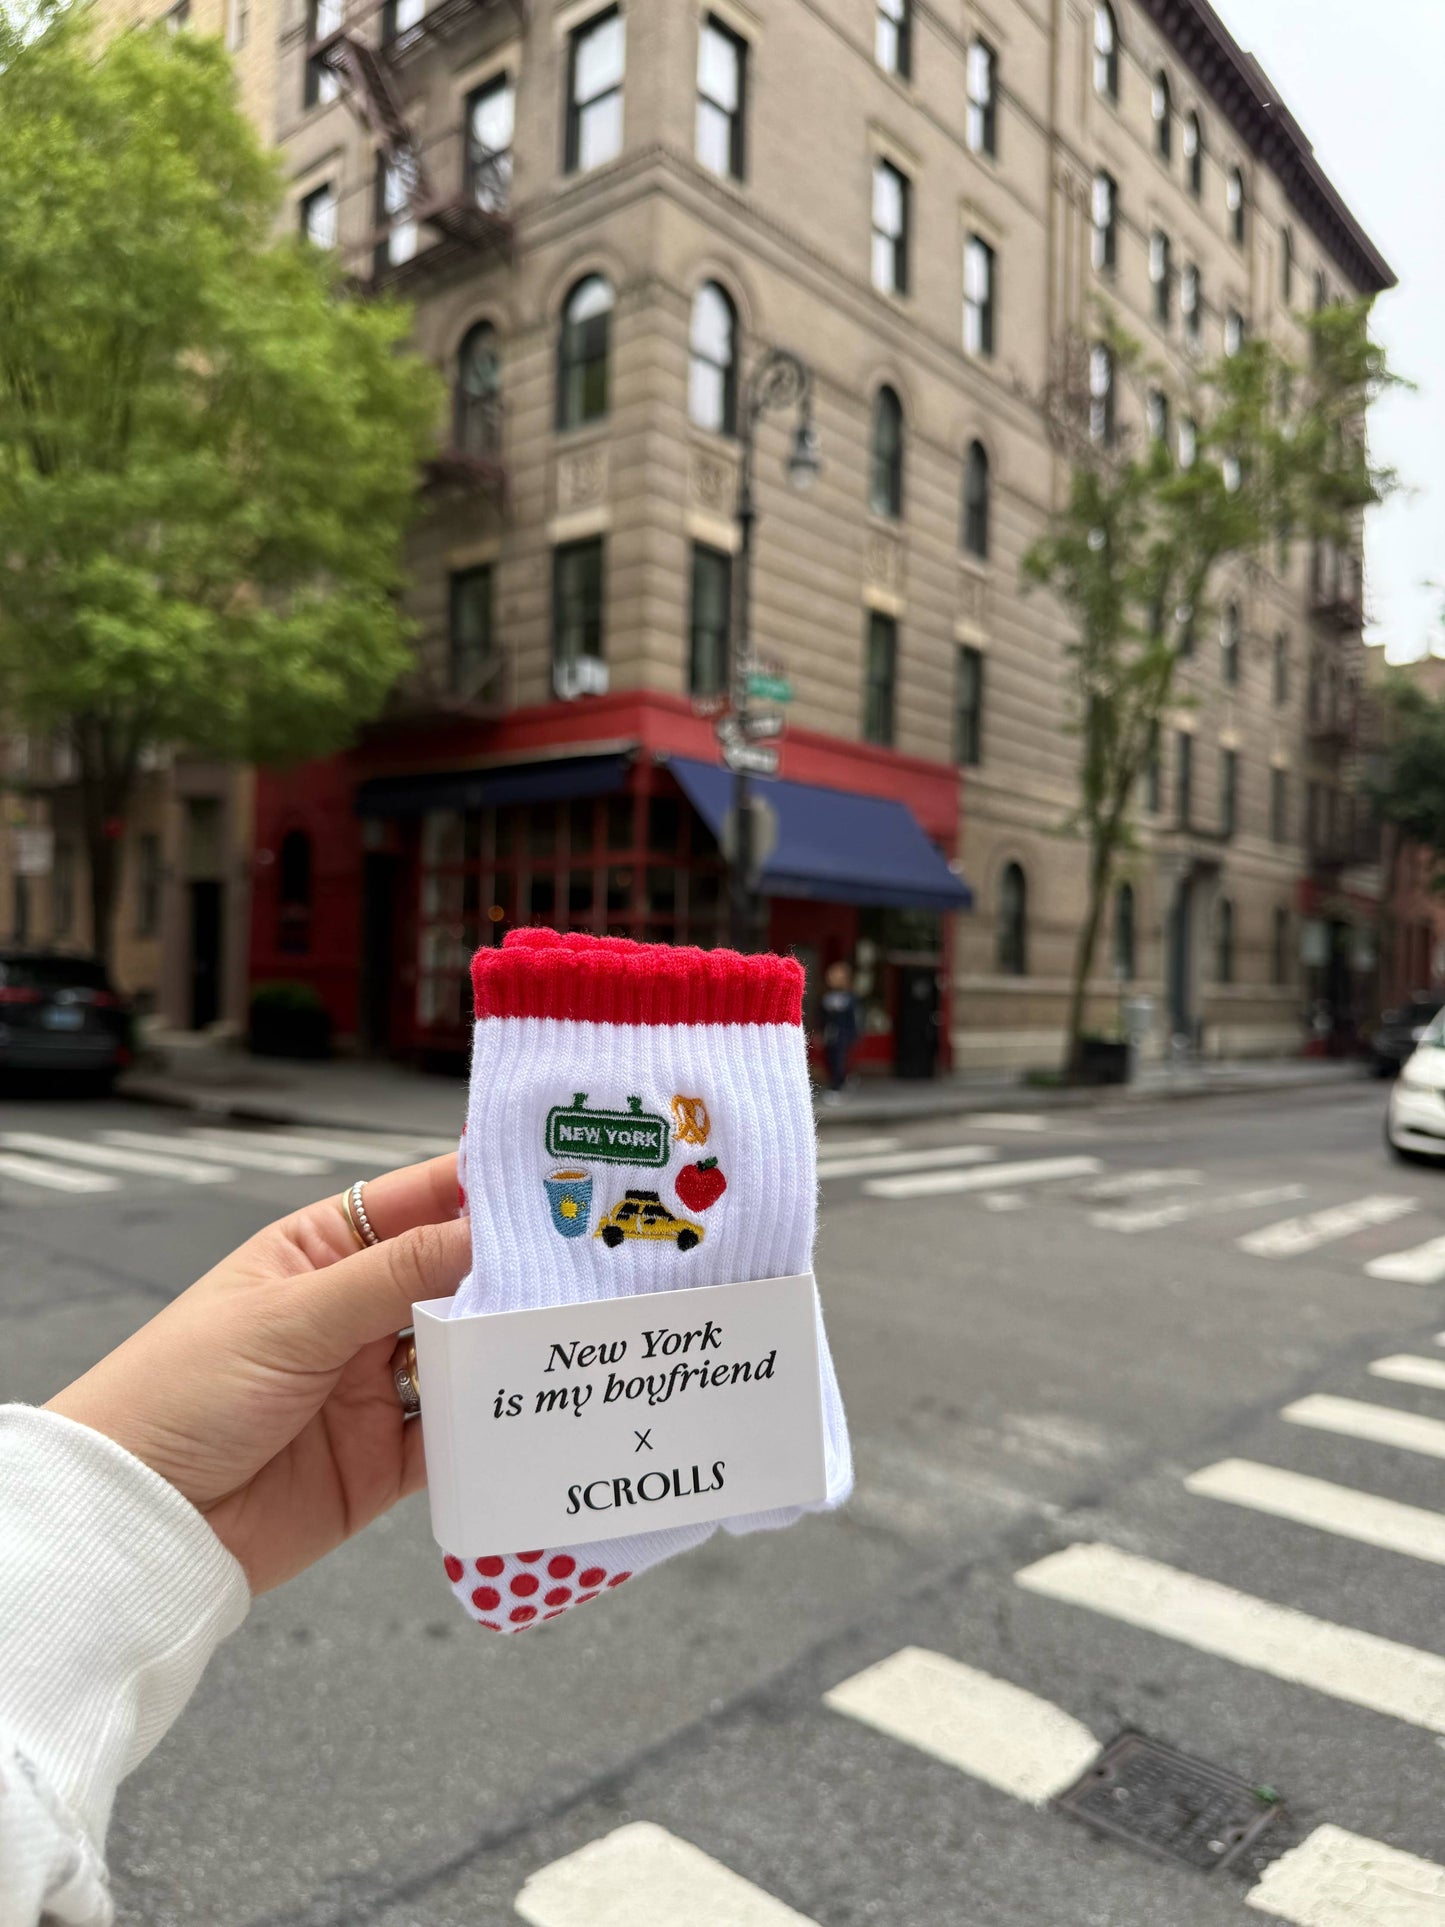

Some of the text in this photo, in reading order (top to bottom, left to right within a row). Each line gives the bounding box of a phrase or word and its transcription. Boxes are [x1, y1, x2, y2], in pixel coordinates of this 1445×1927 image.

[559, 1124, 658, 1147] NEW YORK
[543, 1320, 723, 1373] New York
[492, 1349, 777, 1419] is my boyfriend
[566, 1460, 726, 1515] SCROLLS
